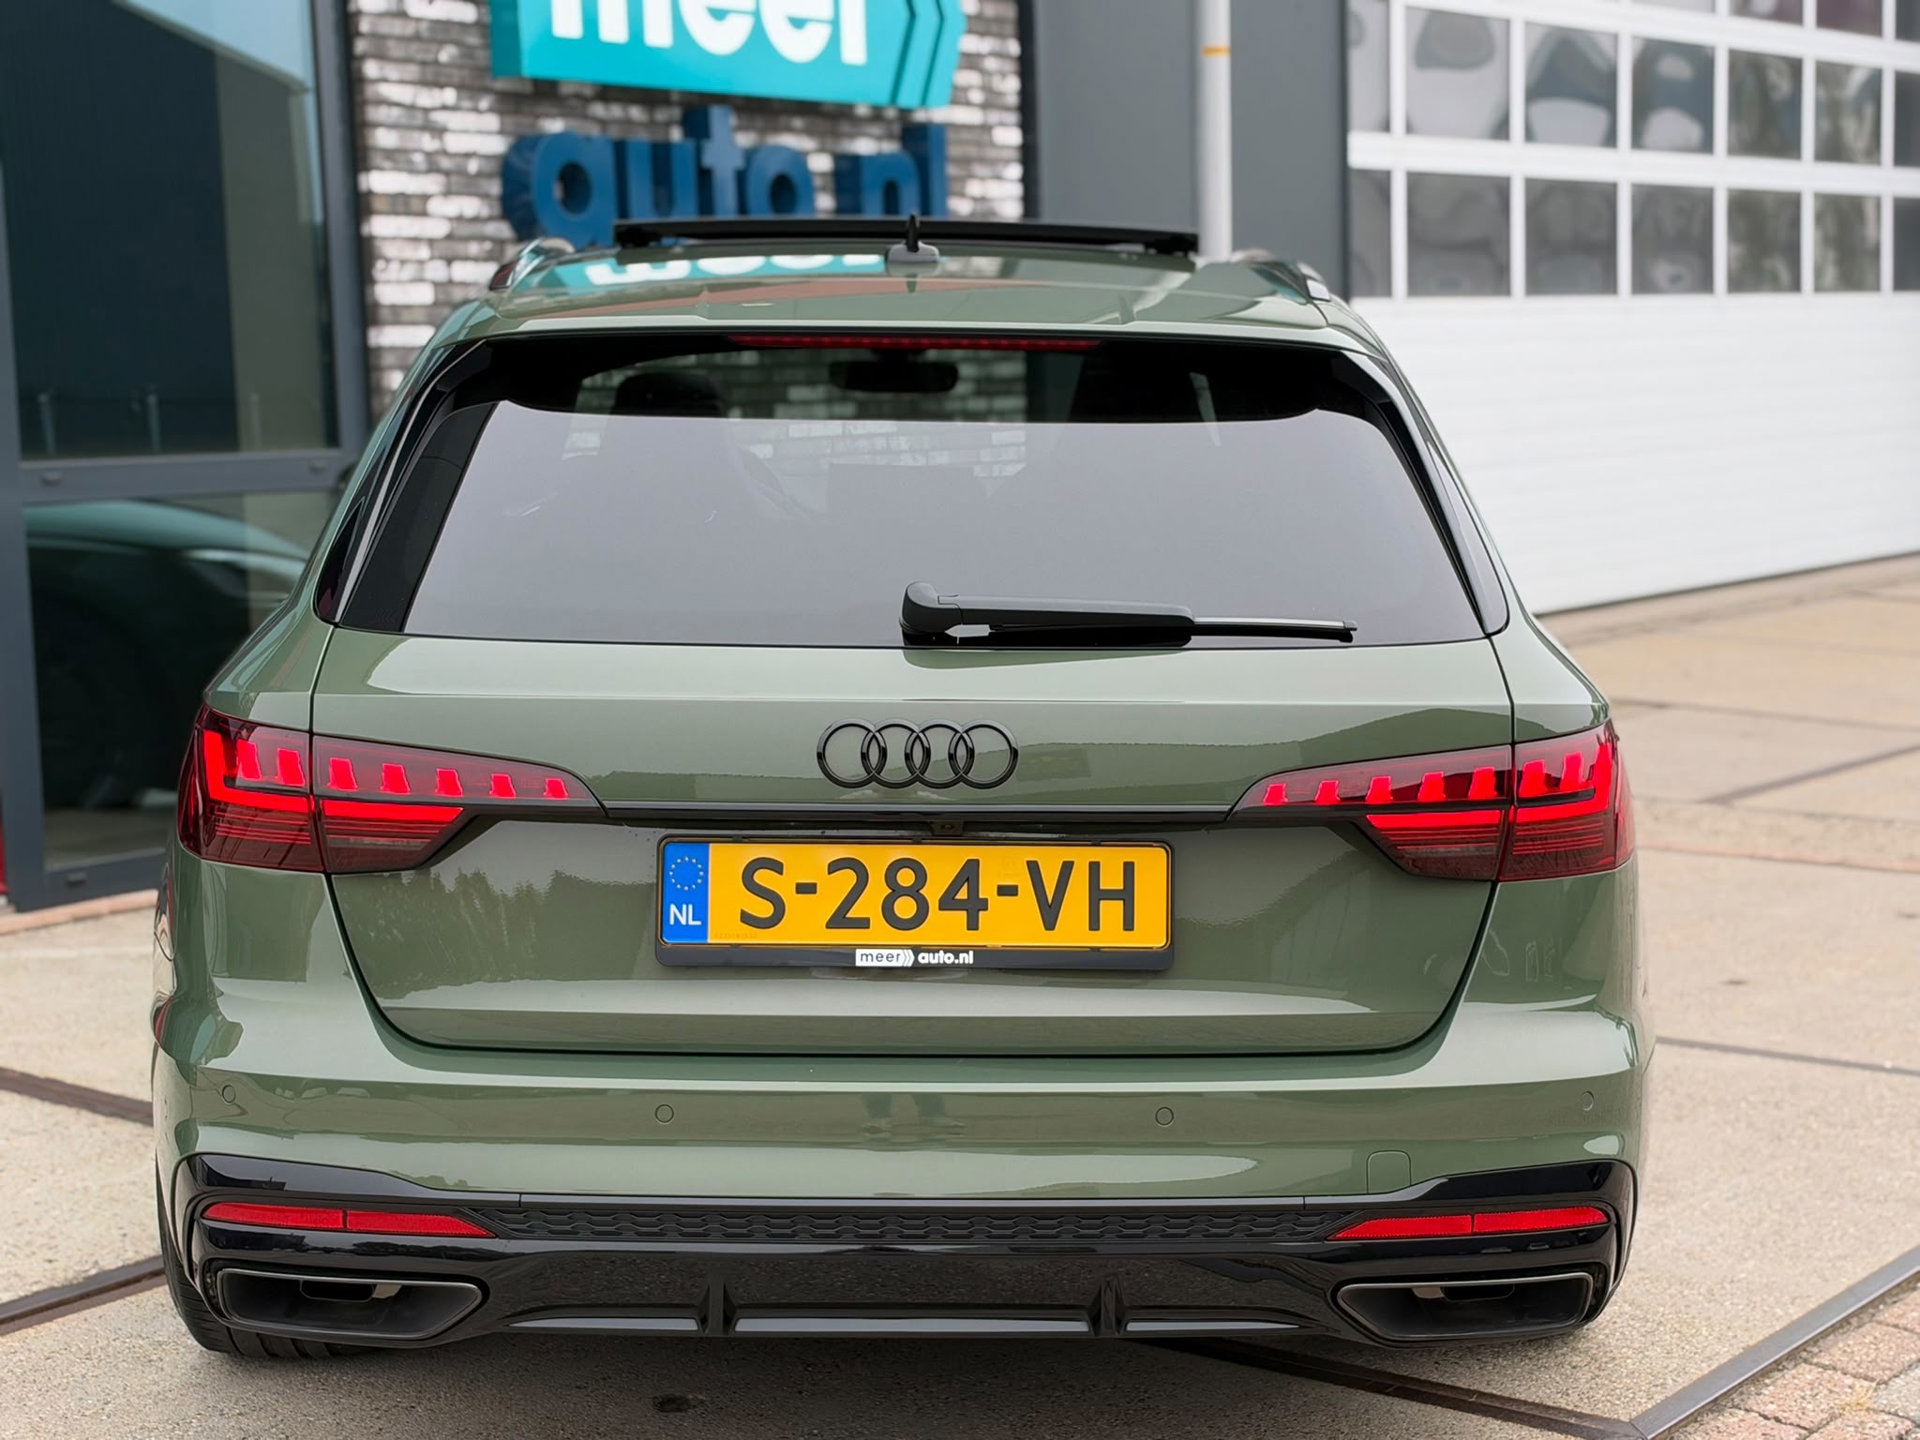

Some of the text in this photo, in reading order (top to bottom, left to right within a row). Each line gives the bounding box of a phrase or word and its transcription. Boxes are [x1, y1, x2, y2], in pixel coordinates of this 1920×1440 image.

[503, 105, 946, 247] autonl
[669, 903, 702, 926] NL
[739, 857, 1136, 932] S-284-VH
[860, 949, 974, 965] meer auto.nl
